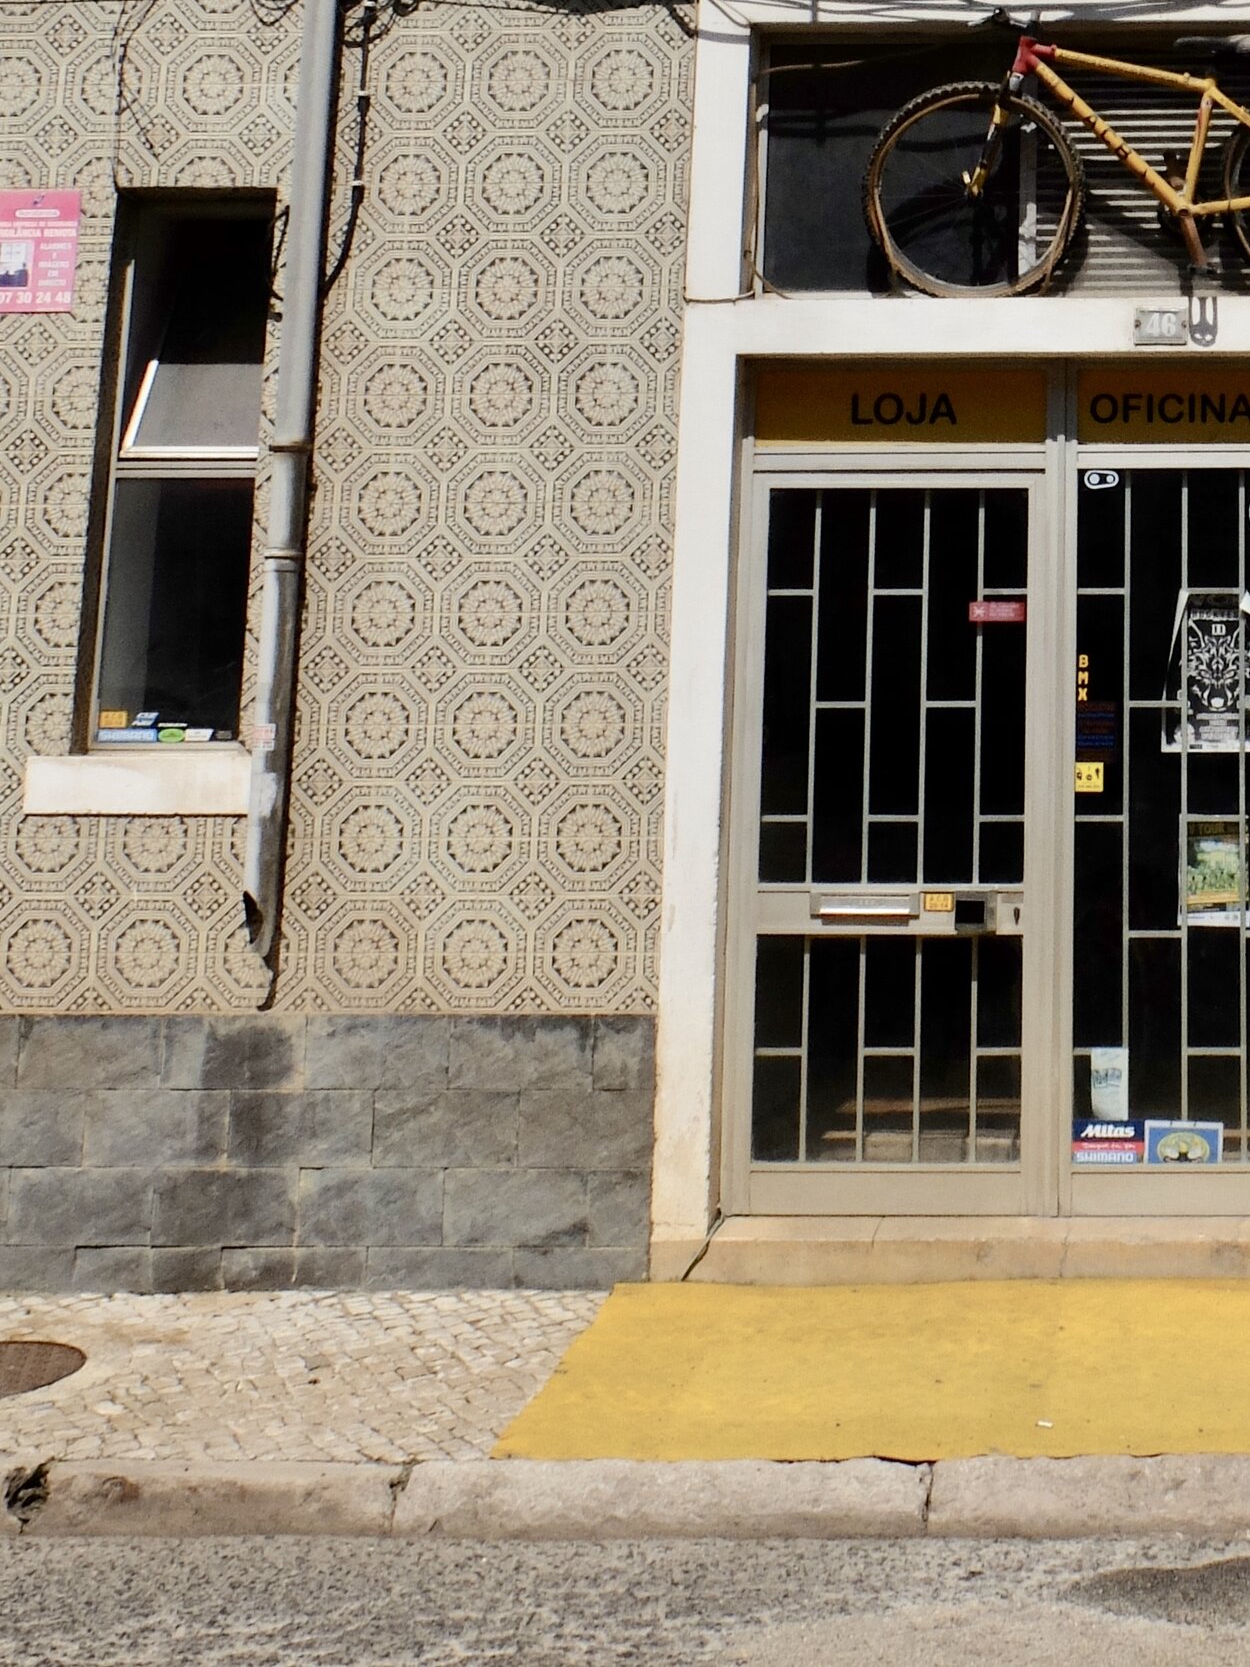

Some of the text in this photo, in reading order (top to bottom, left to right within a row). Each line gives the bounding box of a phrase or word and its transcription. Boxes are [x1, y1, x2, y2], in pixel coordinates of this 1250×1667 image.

[16, 291, 32, 304] 30
[36, 291, 52, 304] 24
[55, 291, 72, 304] 48
[1145, 312, 1177, 337] 46
[850, 392, 957, 426] LOJA
[1080, 1124, 1136, 1139] Mitas
[1076, 1151, 1134, 1163] SHIMANO
